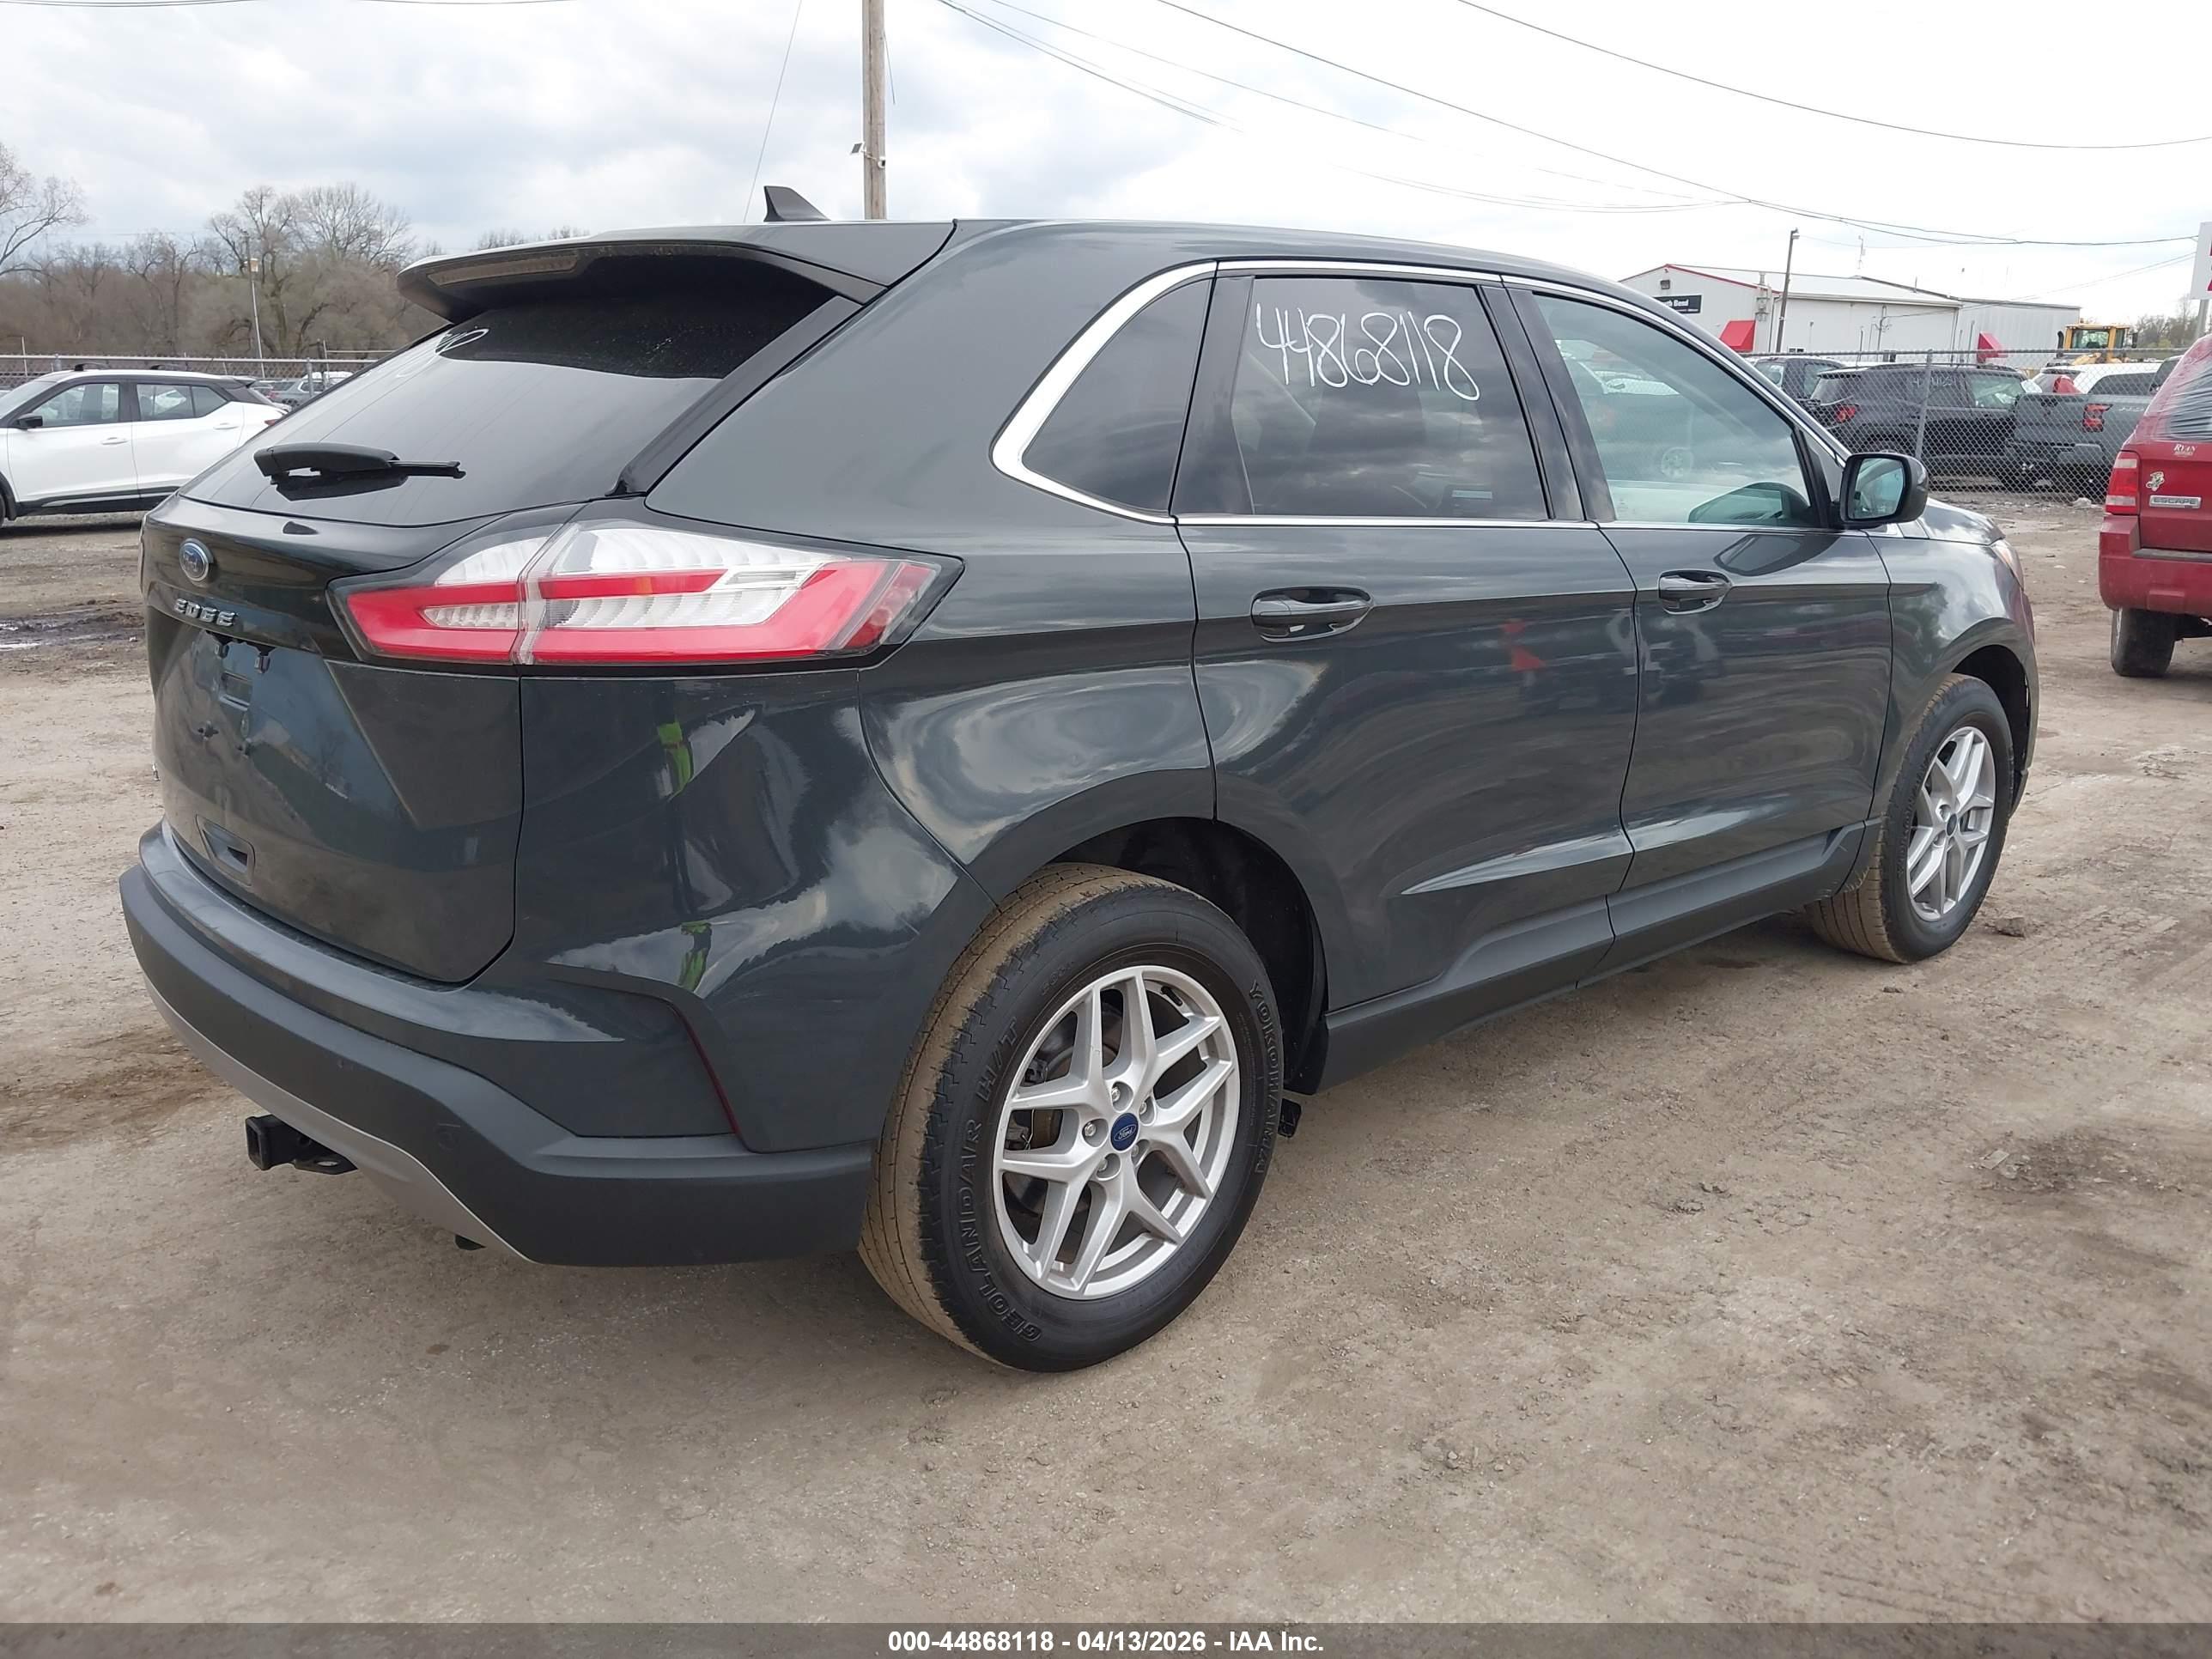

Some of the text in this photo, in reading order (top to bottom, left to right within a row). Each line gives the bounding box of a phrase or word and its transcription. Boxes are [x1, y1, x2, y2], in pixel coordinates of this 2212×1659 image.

[1256, 302, 1480, 401] 44868118
[174, 599, 236, 627] EDGE
[1249, 979, 1280, 1174] YOKOHAMA
[957, 1018, 1042, 1343] GEOLANDAR H/T
